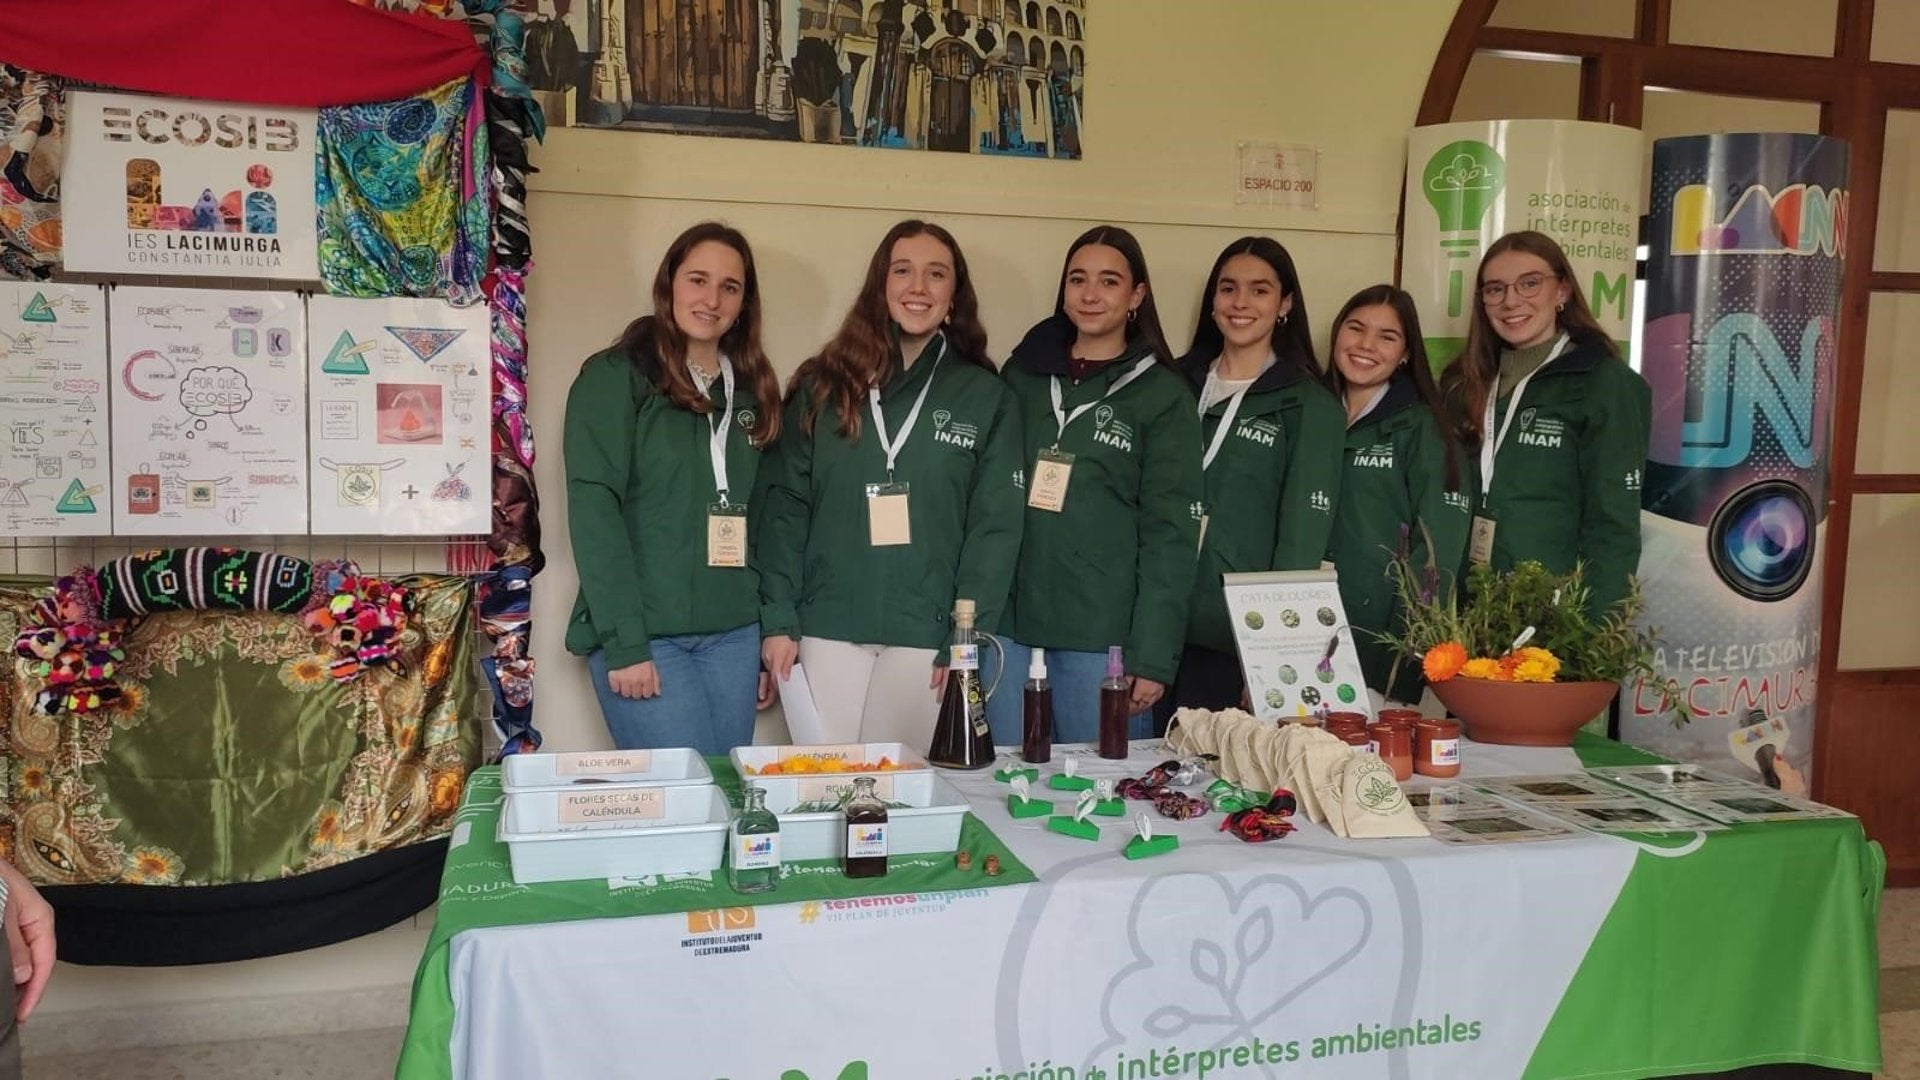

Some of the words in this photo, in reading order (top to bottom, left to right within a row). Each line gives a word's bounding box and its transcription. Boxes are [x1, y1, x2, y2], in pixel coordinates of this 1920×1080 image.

[1245, 177, 1292, 191] ESPACIO
[1294, 180, 1313, 192] 200
[1528, 189, 1619, 211] asociación
[1528, 212, 1631, 238] intérpretes
[127, 233, 157, 249] IES
[167, 235, 281, 253] LACIMURGA
[128, 251, 231, 265] CONSTANTIA
[240, 255, 281, 268] IULIA
[192, 377, 213, 389] POR
[9, 427, 44, 445] YES
[934, 430, 975, 450] INAM
[1094, 430, 1132, 452] INAM
[1236, 426, 1275, 447] INAM
[1518, 431, 1562, 448] INAM
[1353, 456, 1393, 468] INAM
[578, 758, 603, 768] ALOE
[605, 757, 631, 767] VERA
[569, 795, 606, 804] FLORES
[608, 794, 639, 803] SECAS
[640, 793, 653, 802] DE
[582, 806, 641, 817] CALÉNDULA
[1118, 1037, 1299, 1080] intérpretes
[1312, 1015, 1481, 1058] ambientales
